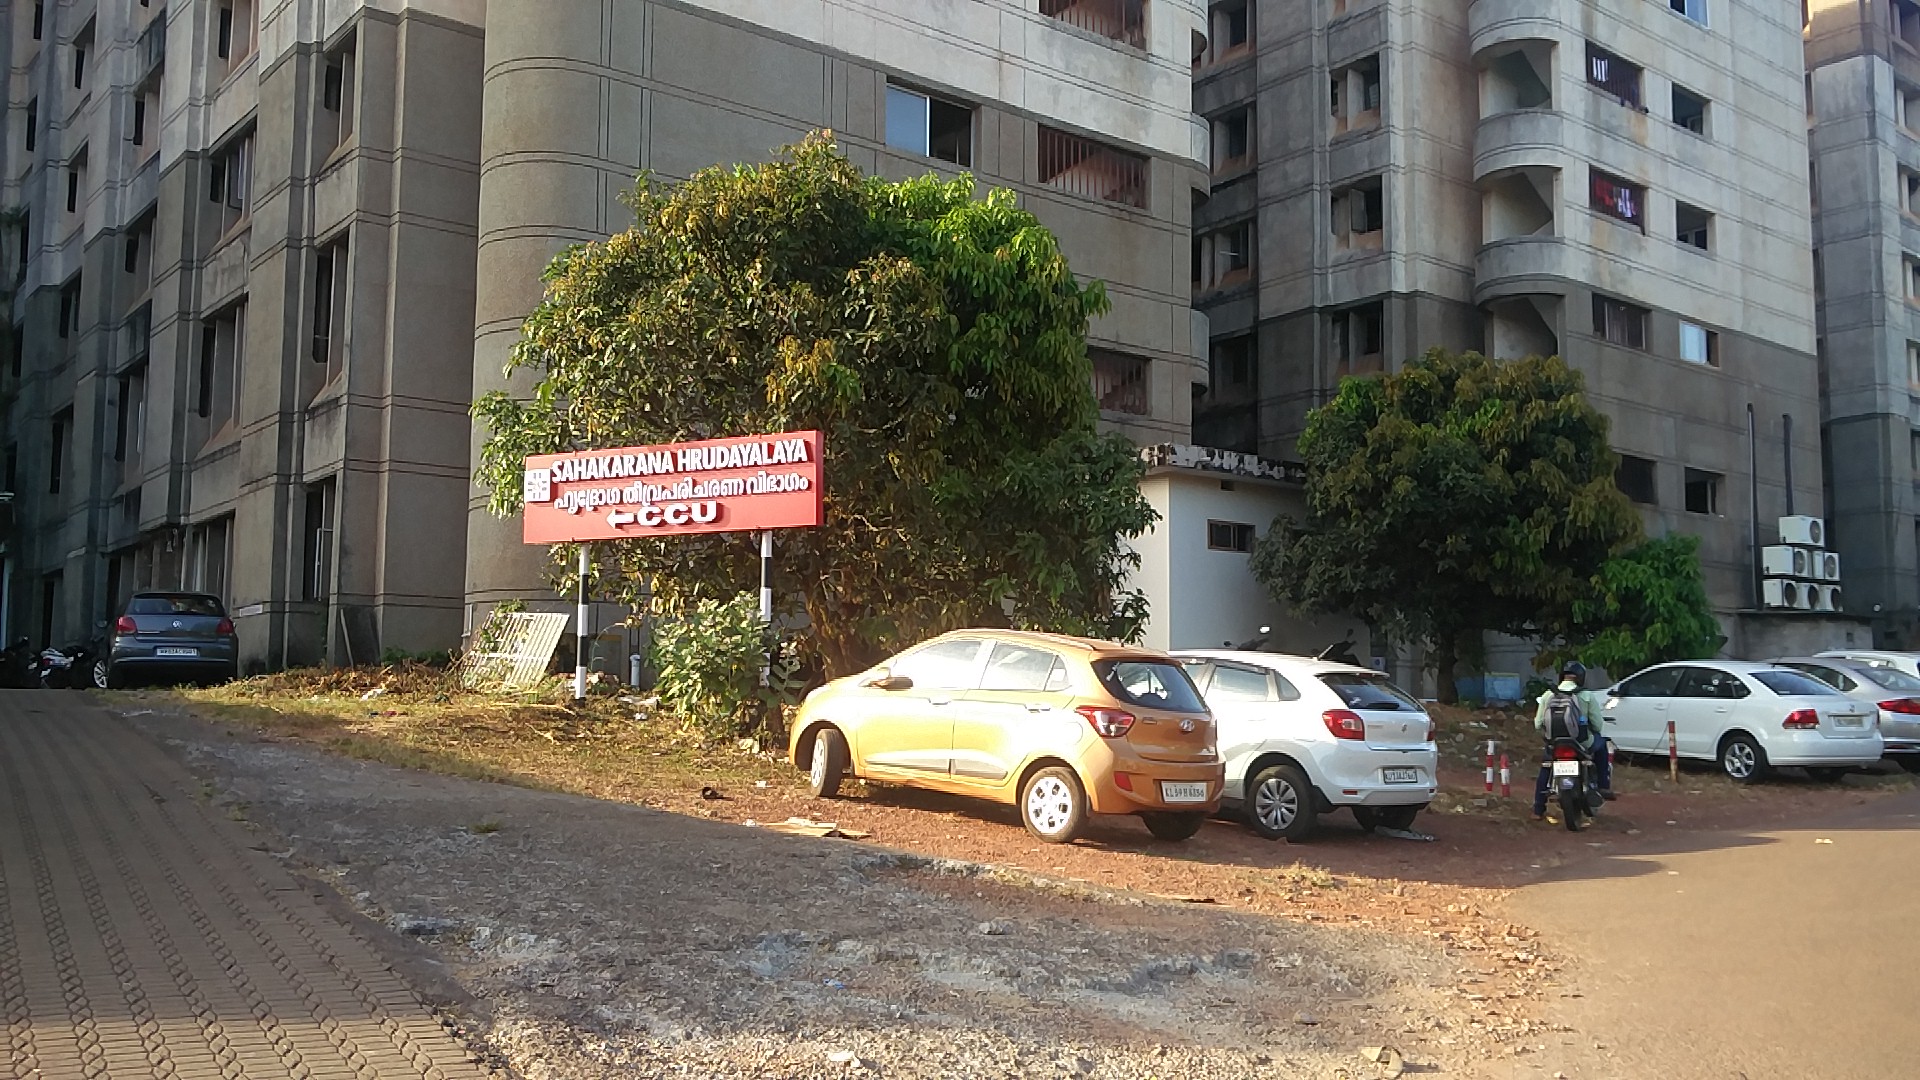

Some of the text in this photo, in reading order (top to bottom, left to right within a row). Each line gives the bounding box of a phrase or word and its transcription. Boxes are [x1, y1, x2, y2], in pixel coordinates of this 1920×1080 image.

[550, 438, 808, 483] SAHAKARANA HRUDAYALAYA
[637, 501, 718, 527] CCU
